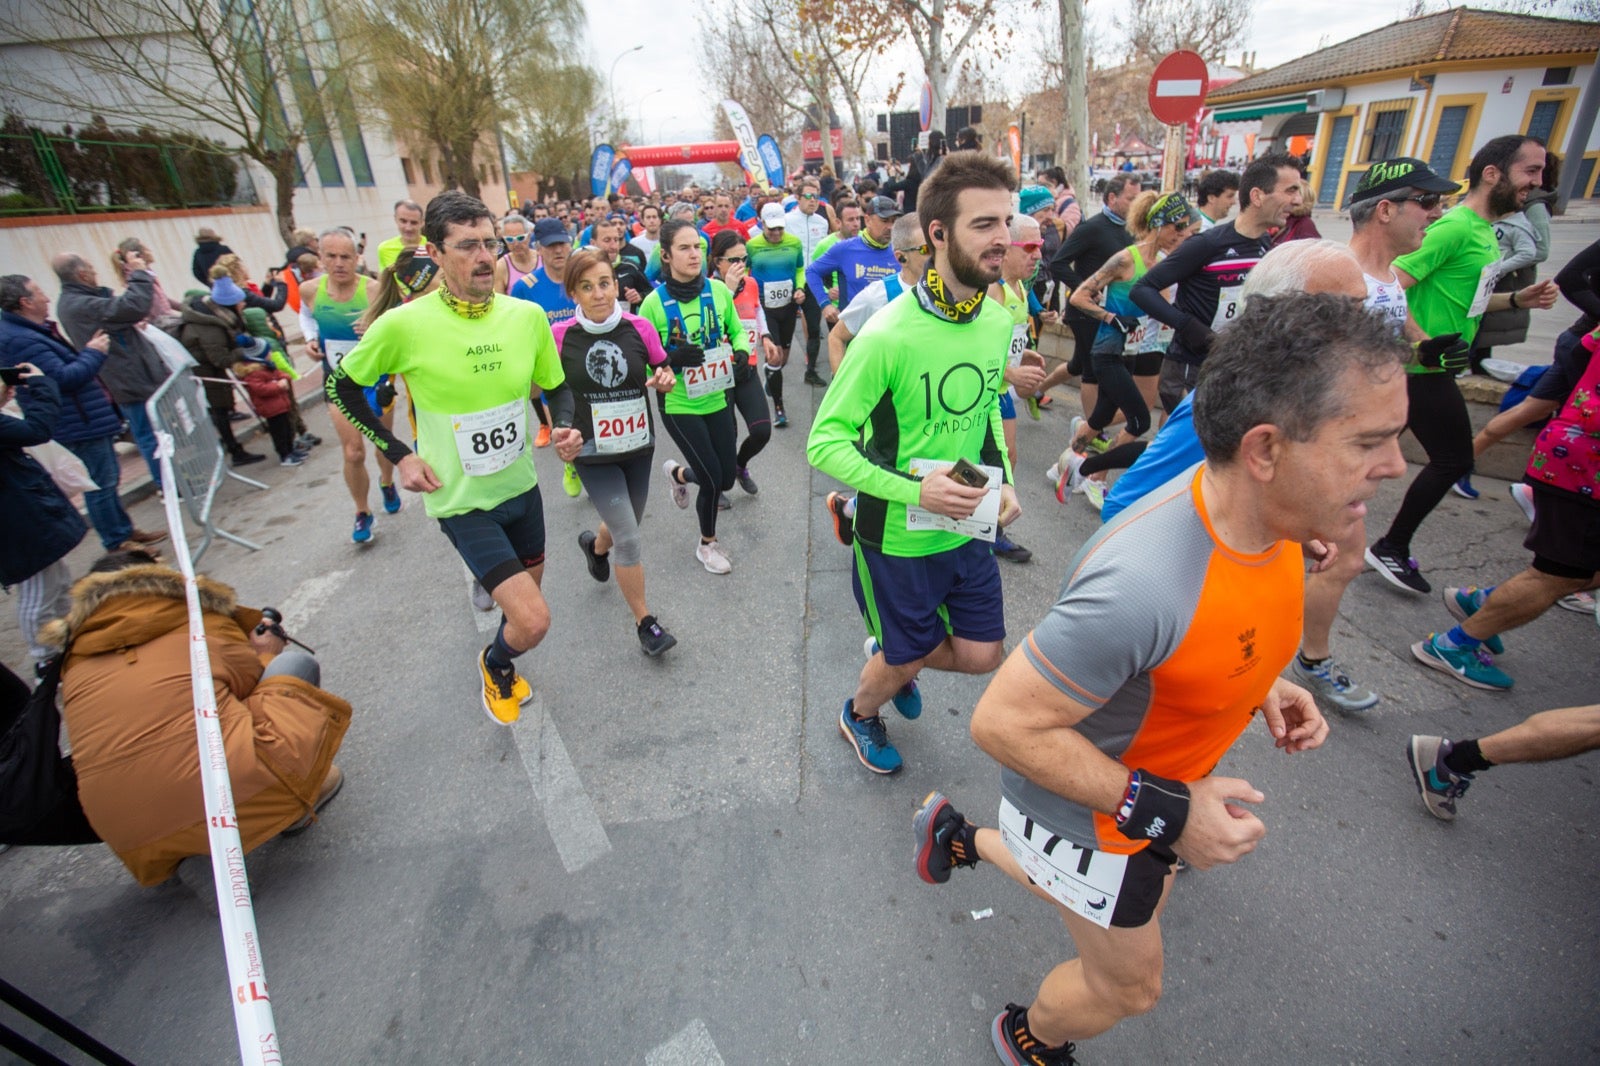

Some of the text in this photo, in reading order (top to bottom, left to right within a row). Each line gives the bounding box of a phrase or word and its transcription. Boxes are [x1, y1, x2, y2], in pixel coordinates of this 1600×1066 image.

[769, 288, 789, 300] 360
[466, 343, 503, 356] ABRIL
[473, 361, 502, 374] 1957
[686, 360, 729, 385] 2171
[471, 421, 518, 454] 863
[598, 412, 647, 438] 2014
[225, 846, 251, 908] DEPORTES
[242, 931, 261, 978] Diputación
